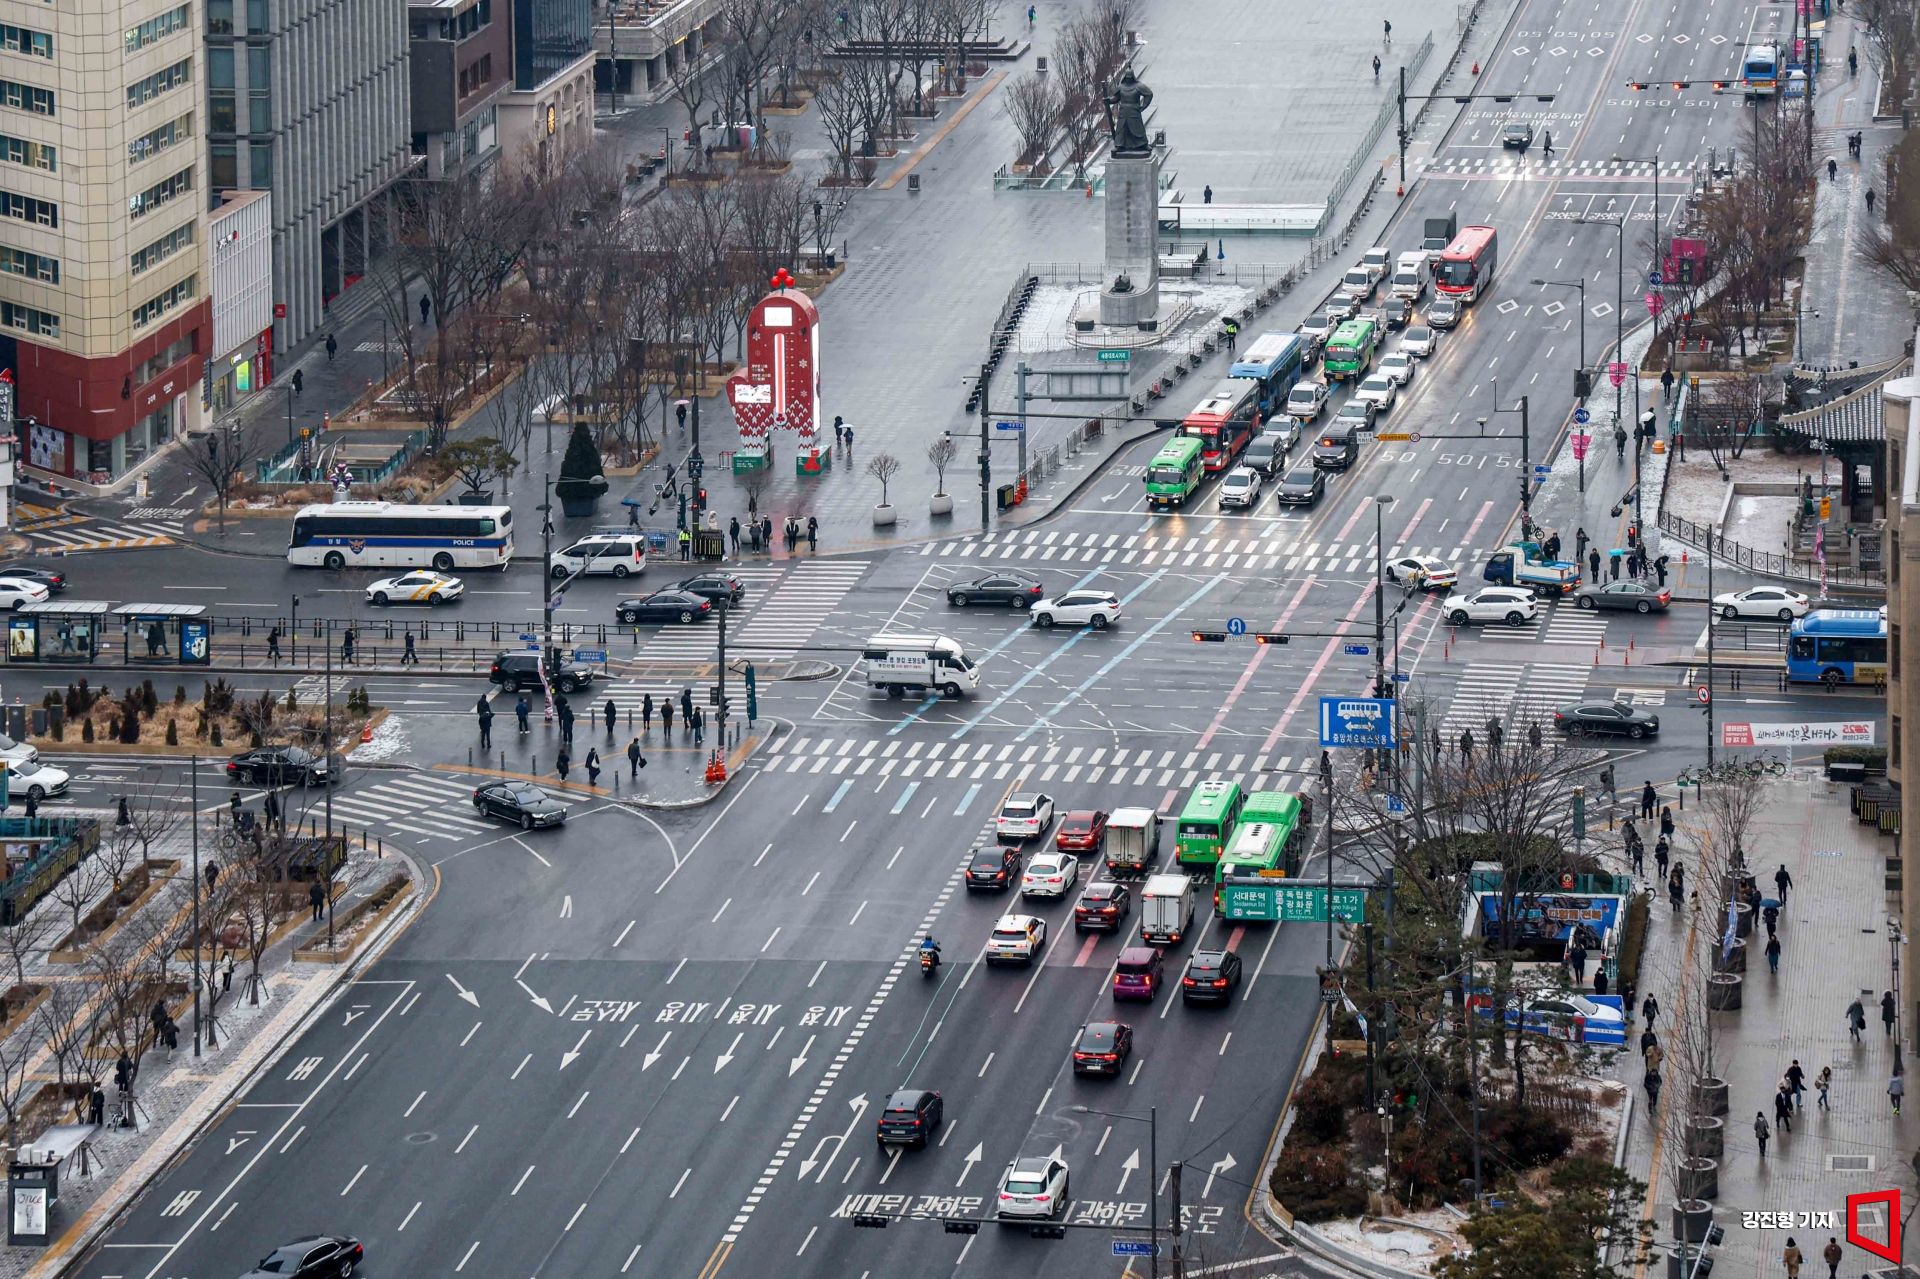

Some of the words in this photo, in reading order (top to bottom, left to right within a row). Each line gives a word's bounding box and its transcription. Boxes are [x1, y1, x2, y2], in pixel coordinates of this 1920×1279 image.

[1607, 99, 1633, 107] 50
[1645, 99, 1671, 107] 50
[1685, 99, 1710, 107] 50
[1382, 451, 1416, 463] 50
[1438, 453, 1473, 466] 50
[1333, 733, 1387, 745] 중앙차로버스전용
[1233, 891, 1266, 901] 서대문역
[1286, 890, 1313, 899] 독립문
[1286, 900, 1313, 909] 광화문
[654, 1001, 710, 1023] 시청
[727, 1004, 783, 1025] 시청
[798, 1006, 853, 1027] 시청
[910, 1195, 983, 1221] 광화문
[1073, 1201, 1148, 1226] 광화문
